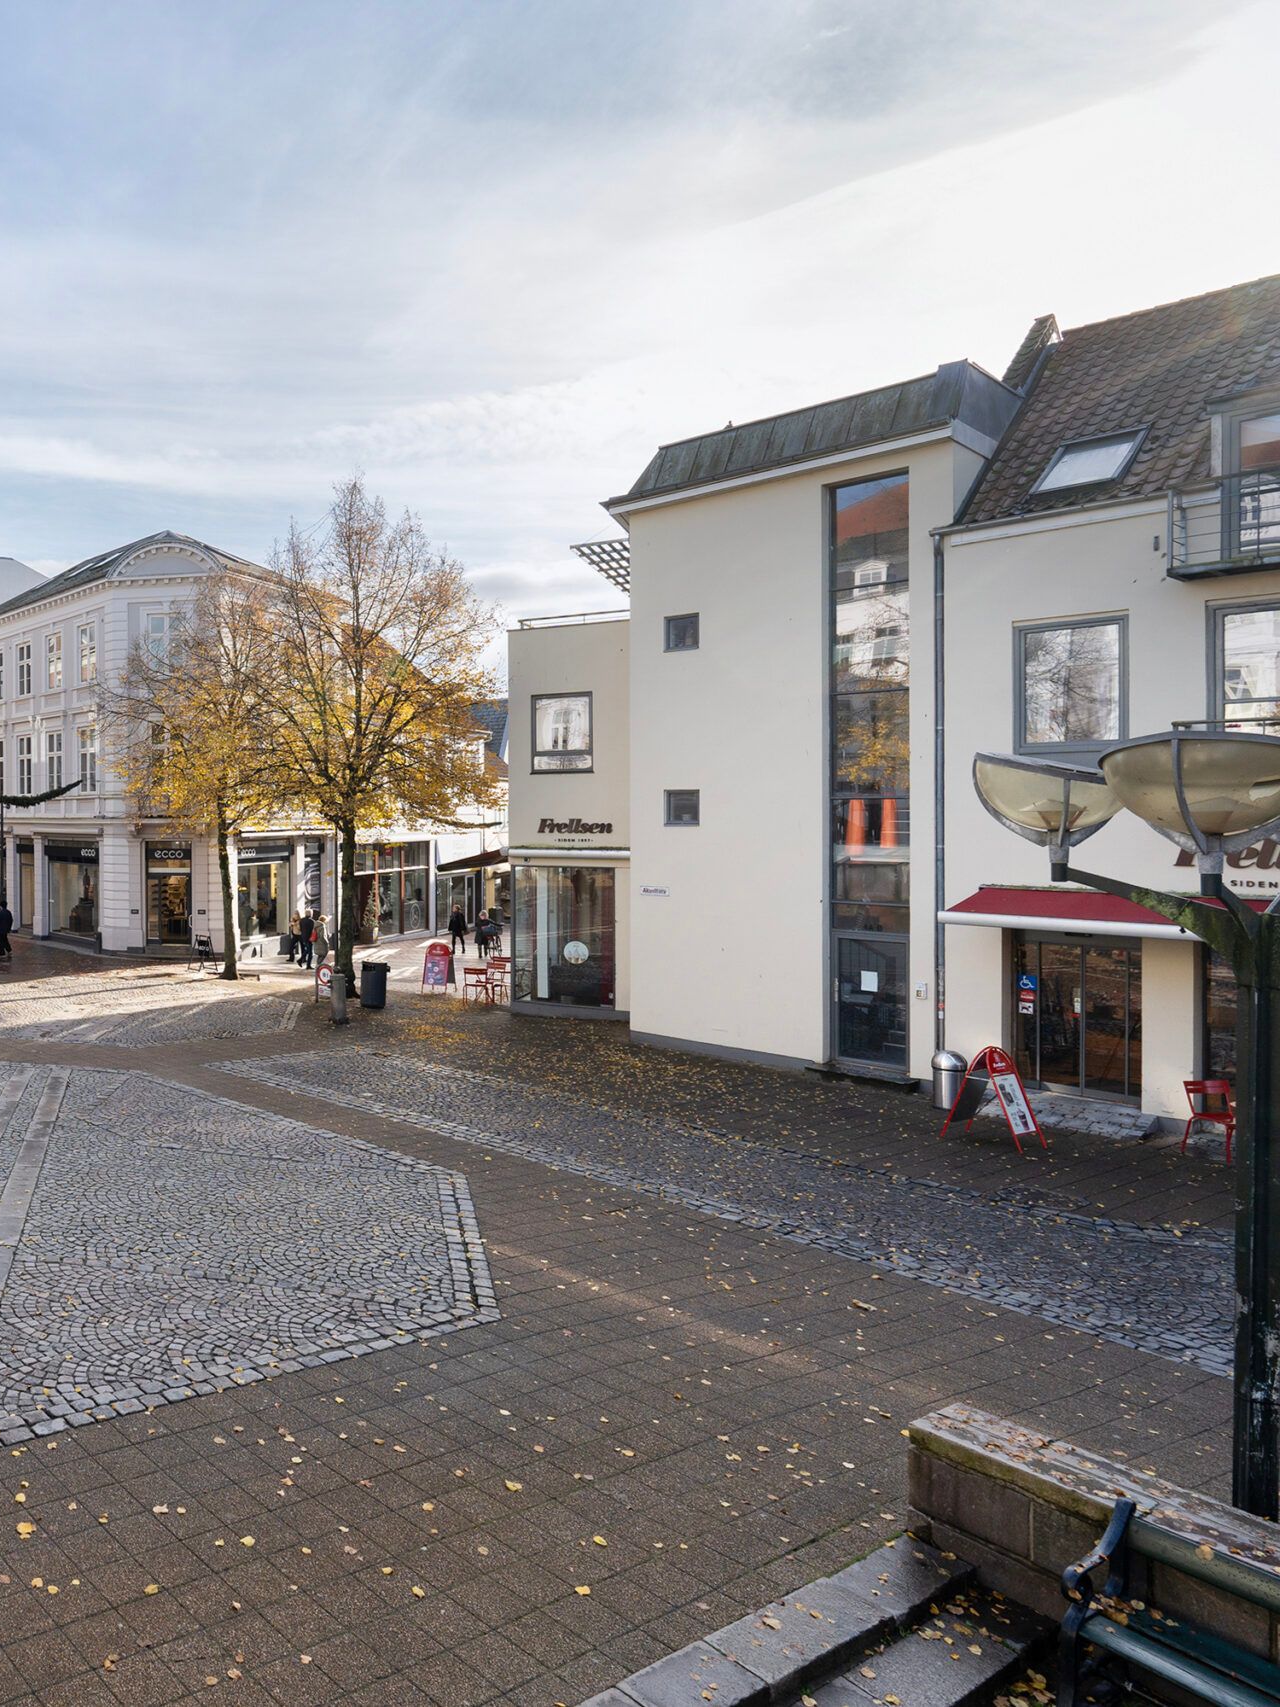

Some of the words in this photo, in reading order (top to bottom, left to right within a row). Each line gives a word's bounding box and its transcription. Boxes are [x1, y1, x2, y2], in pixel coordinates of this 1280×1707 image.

[537, 818, 613, 834] Frellsen
[81, 848, 96, 857] ecco
[154, 850, 183, 859] ecco
[240, 848, 256, 857] ecco
[1230, 879, 1278, 889] SIDEN
